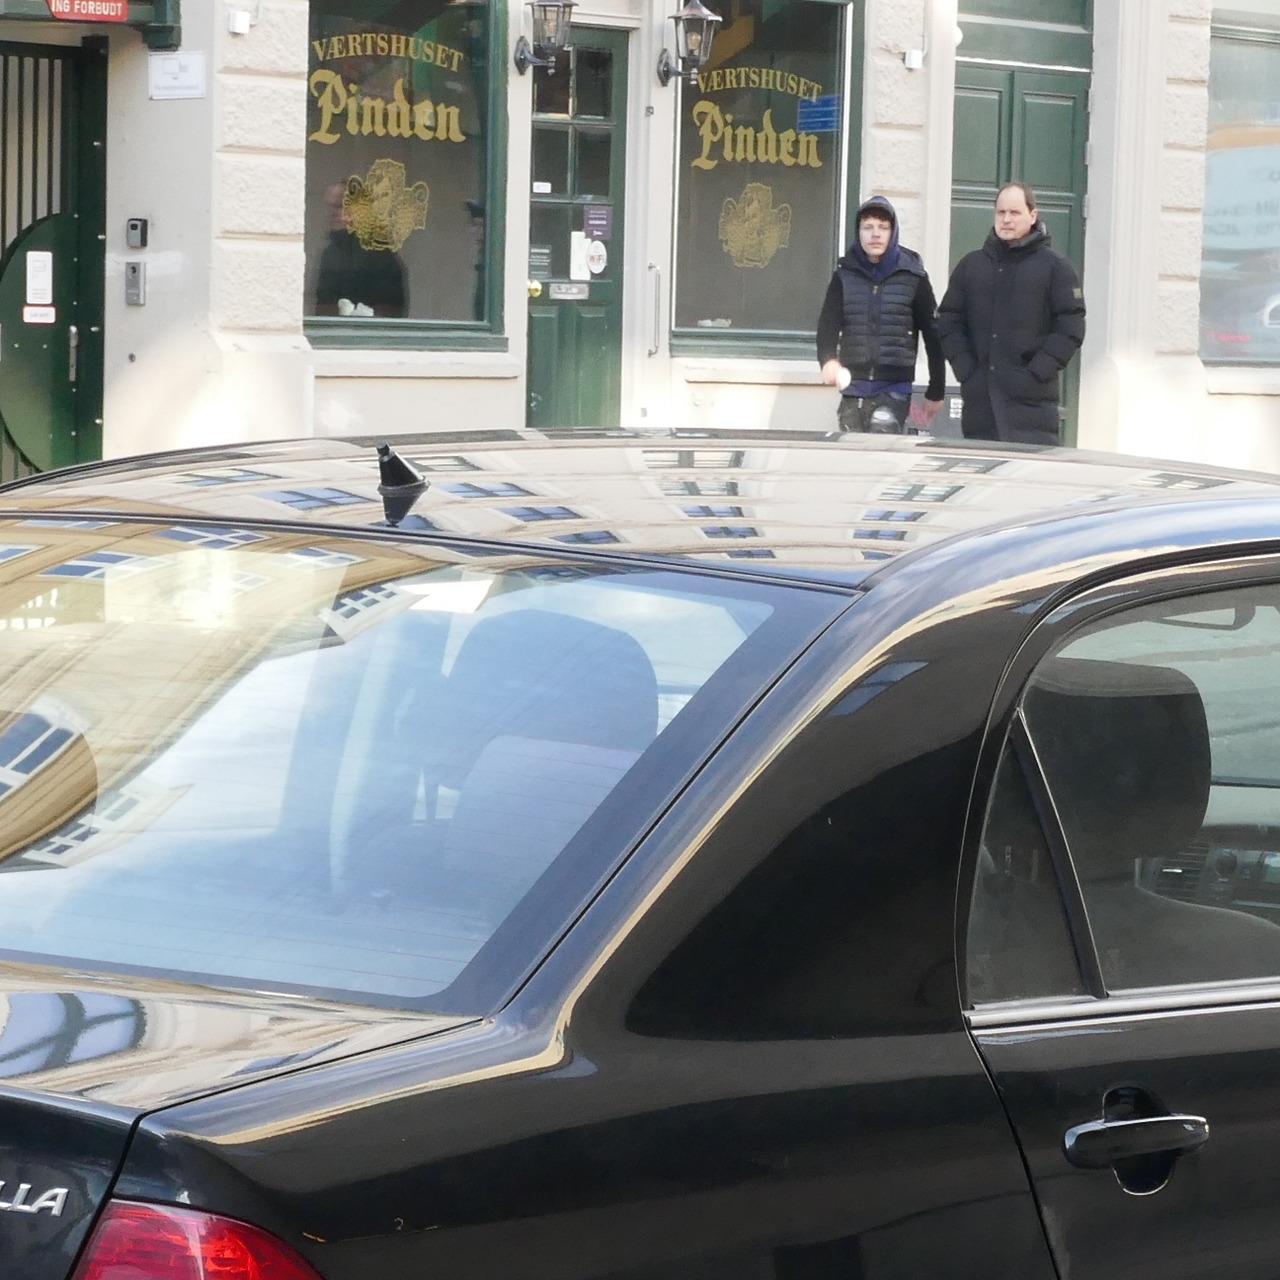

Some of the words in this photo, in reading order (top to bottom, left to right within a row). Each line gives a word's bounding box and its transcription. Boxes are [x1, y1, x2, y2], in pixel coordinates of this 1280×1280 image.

[74, 0, 123, 16] FORBUDT
[312, 33, 464, 73] VÆRTSHUSET
[696, 67, 822, 103] VÆRTSHUSET
[308, 68, 467, 145] Pinden
[690, 100, 823, 171] Pinden
